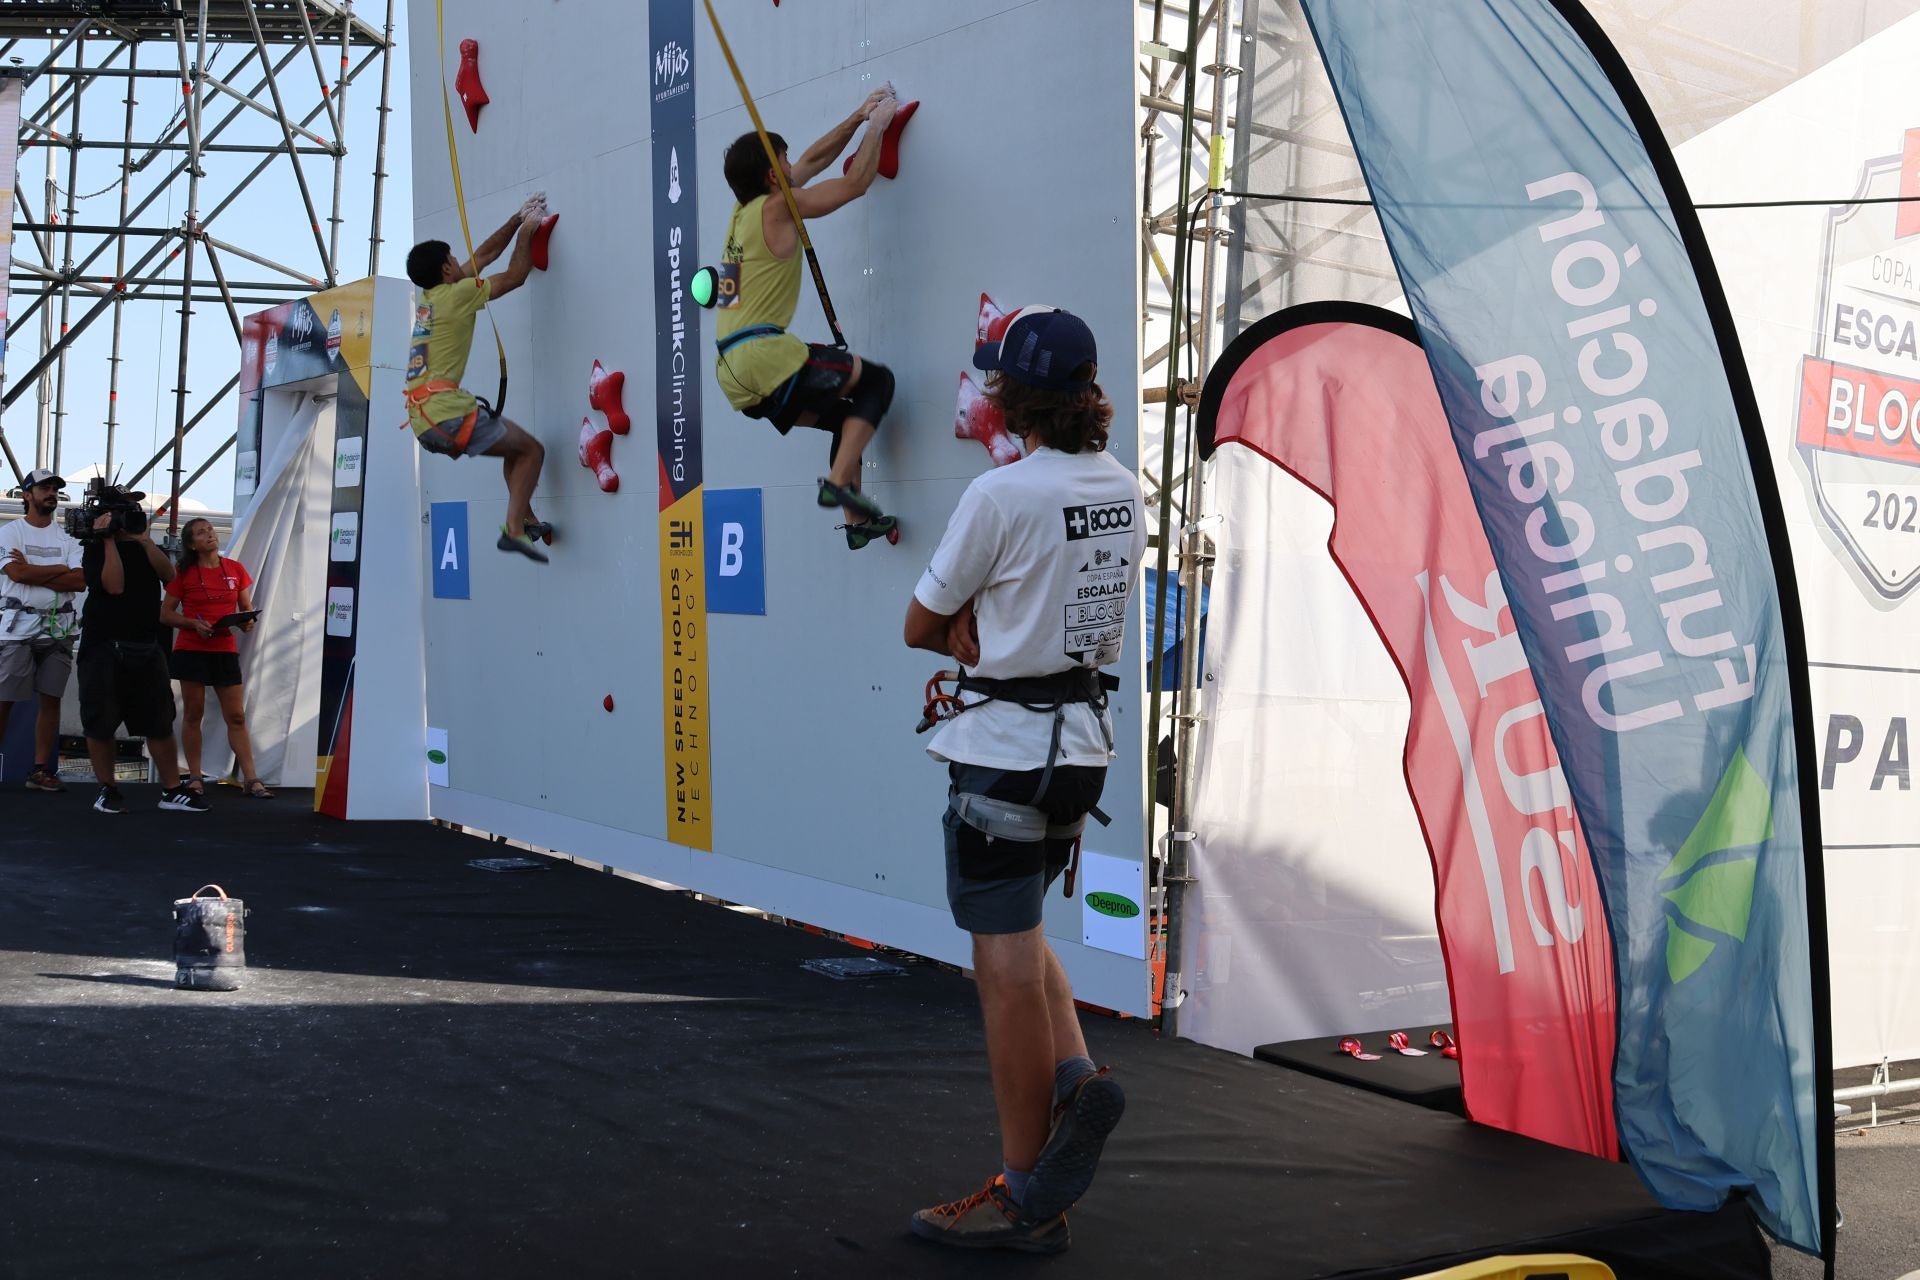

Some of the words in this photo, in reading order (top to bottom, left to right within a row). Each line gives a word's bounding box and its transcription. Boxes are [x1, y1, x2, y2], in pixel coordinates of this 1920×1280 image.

[655, 41, 689, 87] Mijas
[1872, 254, 1913, 290] COPA
[668, 226, 686, 482] SputnikClimbing
[1834, 303, 1920, 362] ESCA
[1863, 489, 1920, 534] 202
[440, 527, 459, 571] A
[719, 522, 745, 577] B
[671, 567, 682, 657] HOLDS
[1078, 582, 1127, 599] ESCALAD
[1078, 601, 1125, 623] BLOQU
[674, 667, 684, 752] SPEED
[686, 568, 700, 824] TECHNOLOGY
[676, 763, 686, 823] NEW
[1092, 894, 1133, 915] Deepron
